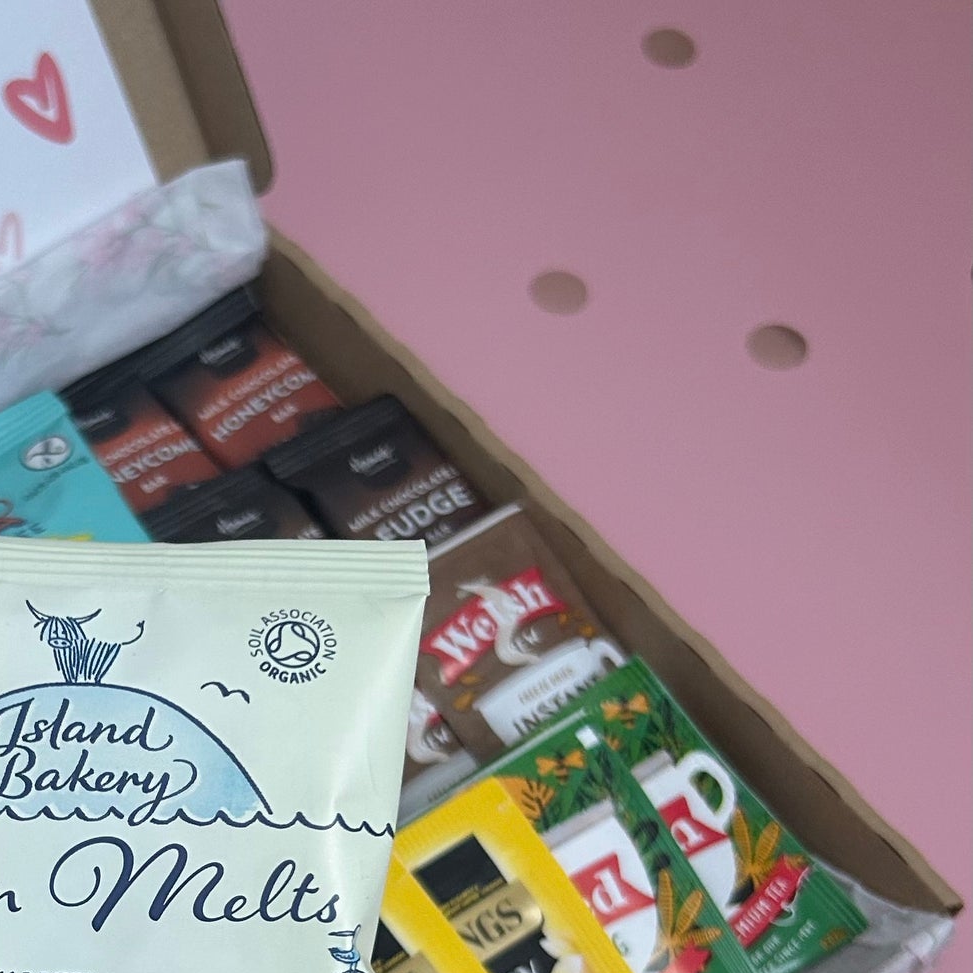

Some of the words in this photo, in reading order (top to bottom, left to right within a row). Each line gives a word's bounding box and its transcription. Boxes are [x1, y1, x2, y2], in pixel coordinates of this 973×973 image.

[374, 481, 475, 542] FUDGE
[248, 627, 266, 658] SOIL
[260, 608, 338, 661] ASSOCIATION
[429, 578, 553, 666] Welsh
[259, 661, 328, 685] ORGANIC
[49, 835, 341, 932] Melts
